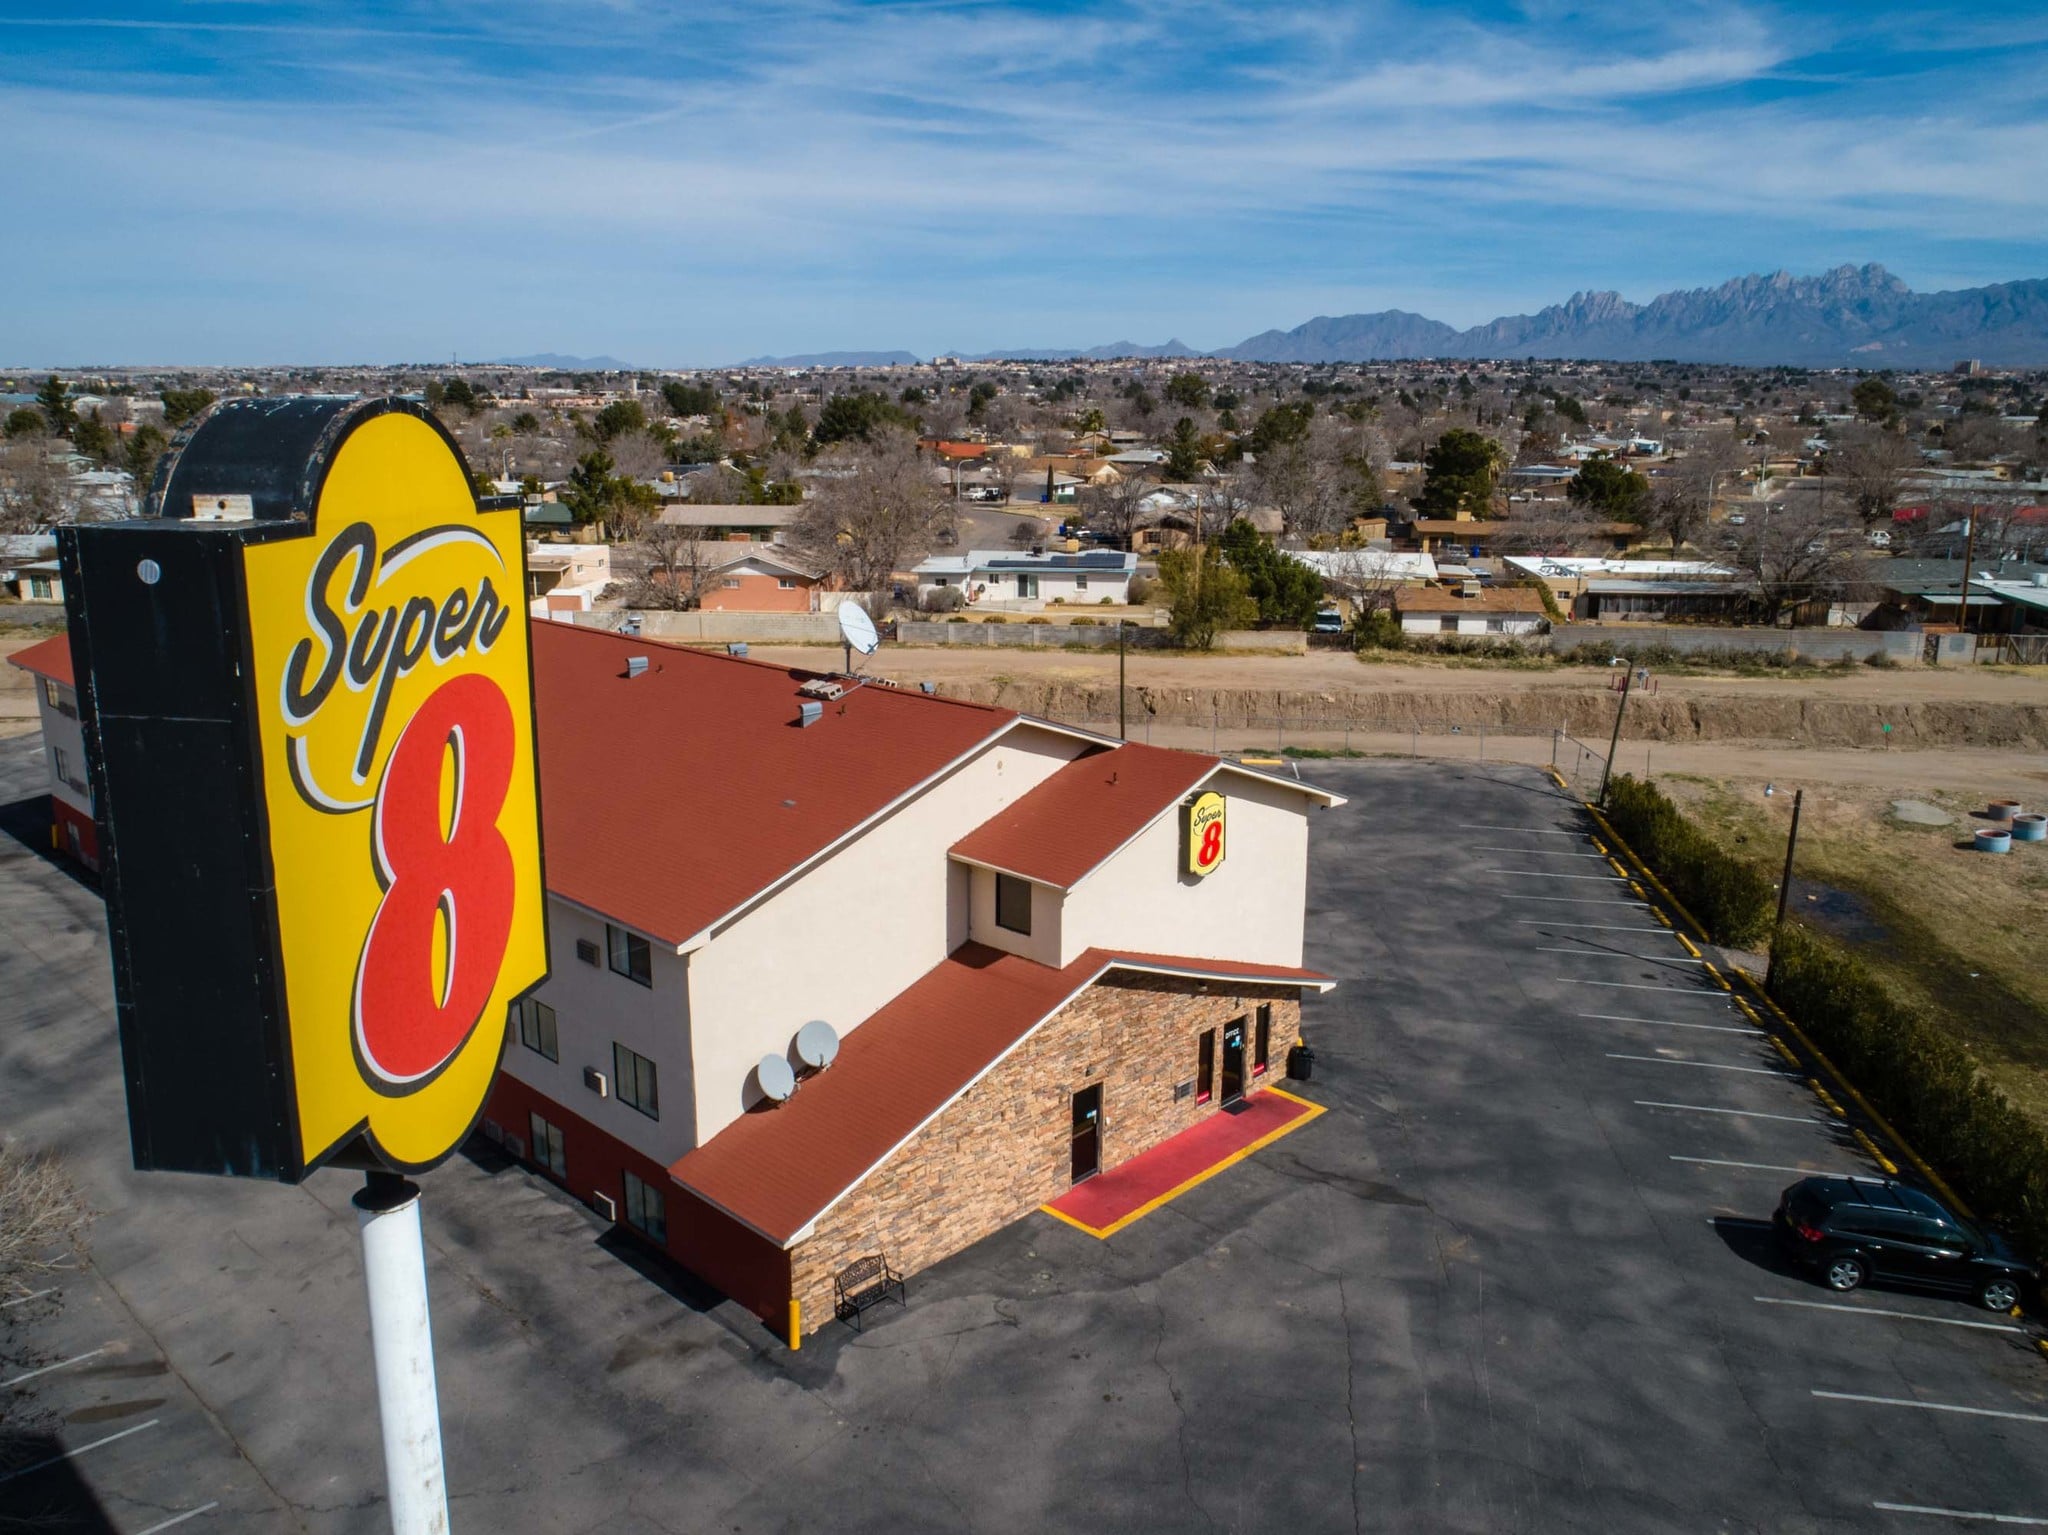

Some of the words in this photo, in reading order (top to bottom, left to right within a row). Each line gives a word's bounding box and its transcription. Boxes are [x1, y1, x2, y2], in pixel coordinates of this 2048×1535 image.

[281, 521, 509, 786] Super
[350, 673, 515, 1098] 8
[1194, 806, 1222, 833] Super
[1197, 820, 1222, 867] 8
